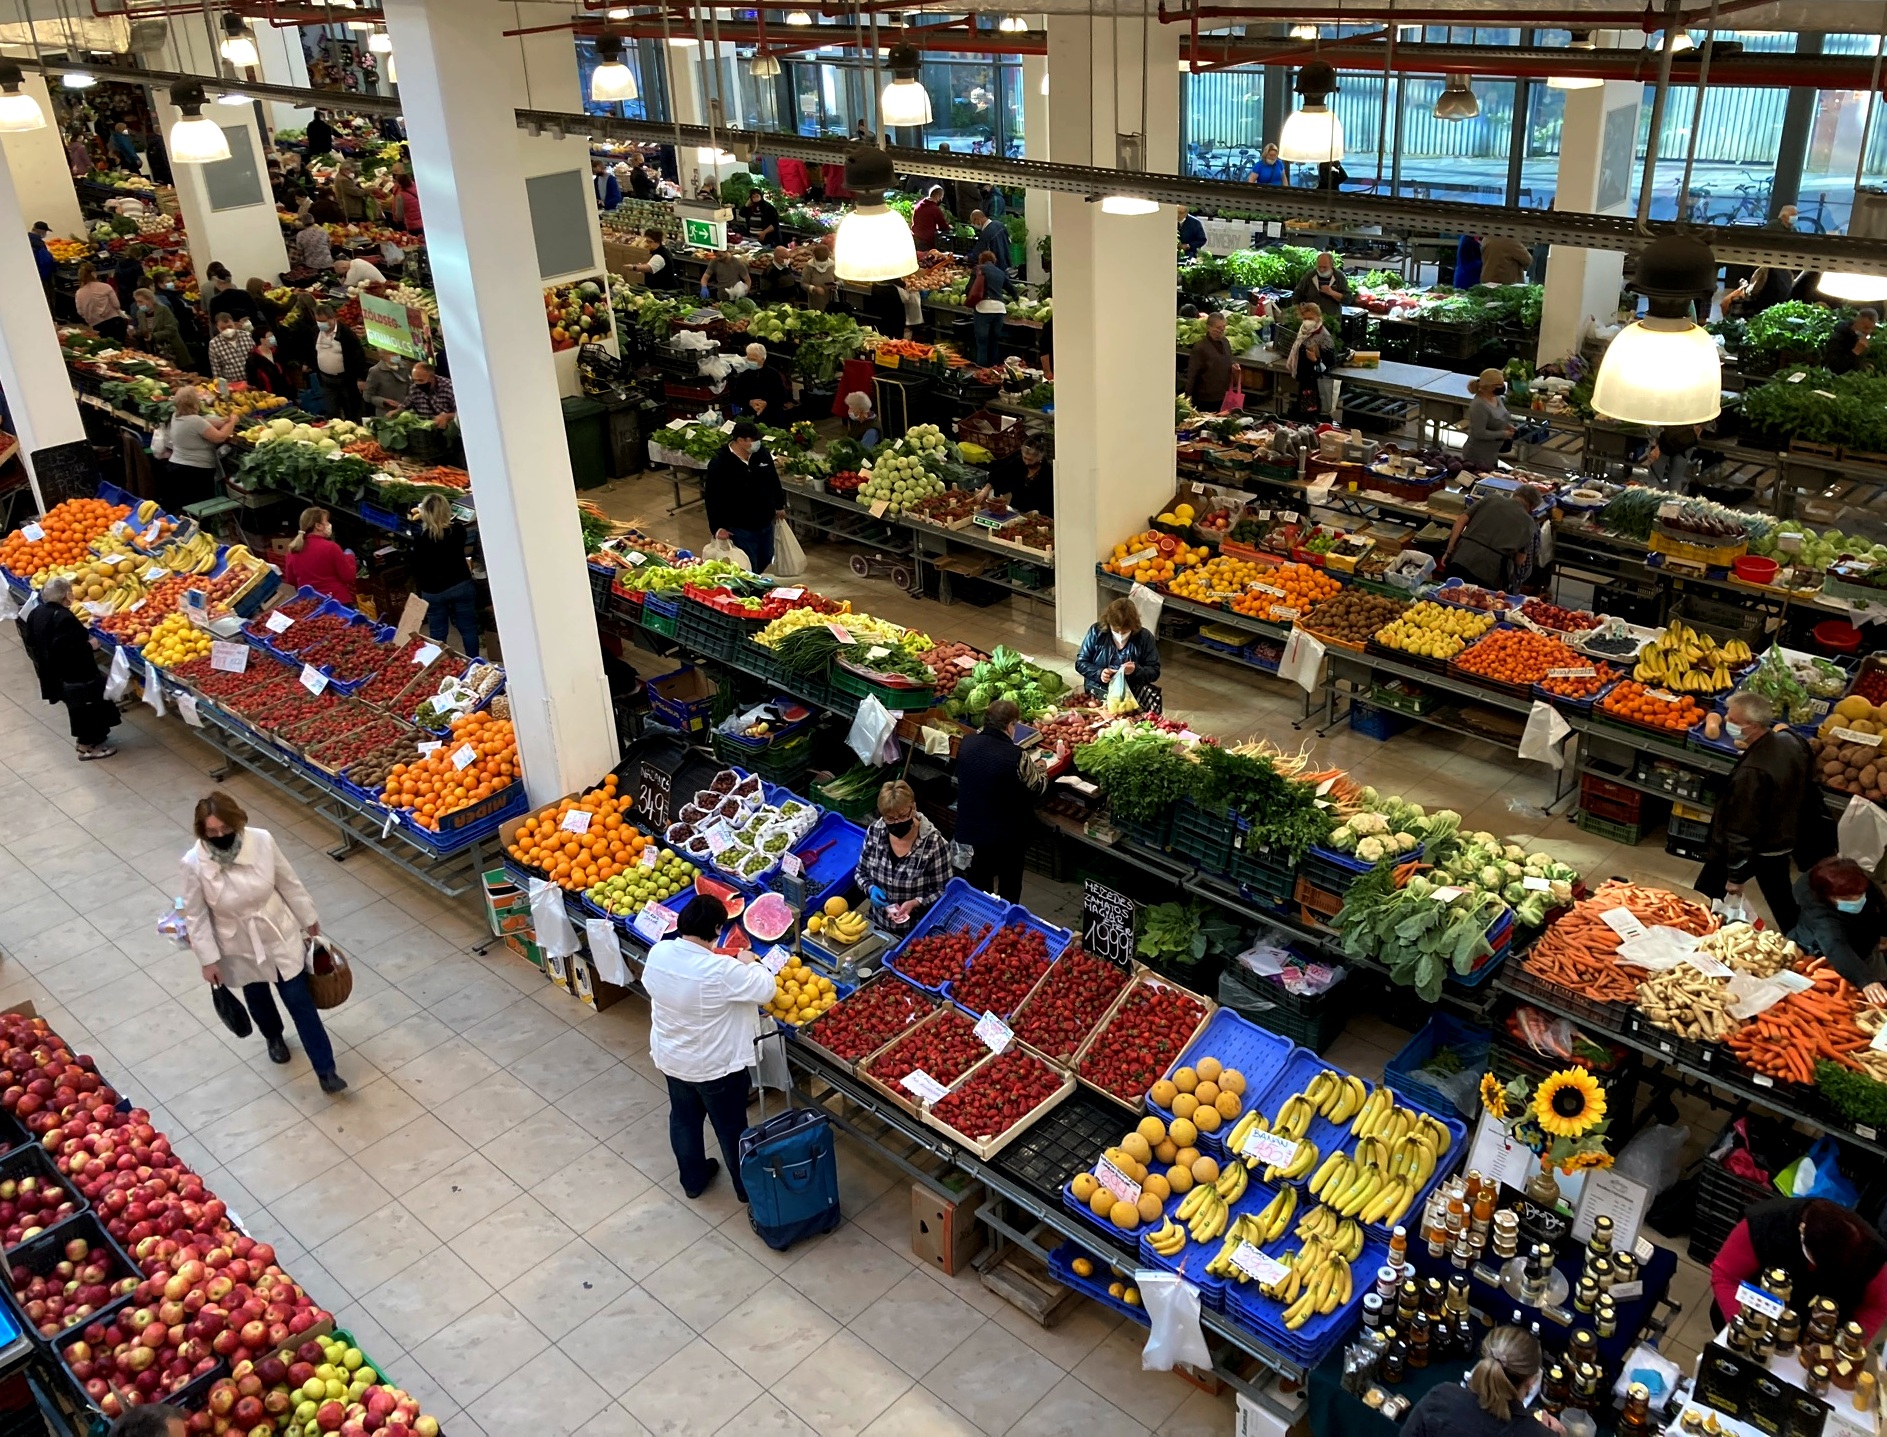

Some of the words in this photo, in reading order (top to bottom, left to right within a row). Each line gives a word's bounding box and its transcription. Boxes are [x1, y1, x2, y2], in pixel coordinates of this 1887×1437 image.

[638, 784, 664, 827] 349
[1084, 920, 1130, 965] 1999
[1254, 1140, 1284, 1161] 450
[1101, 1169, 1128, 1199] 699
[1236, 1249, 1273, 1274] 390
